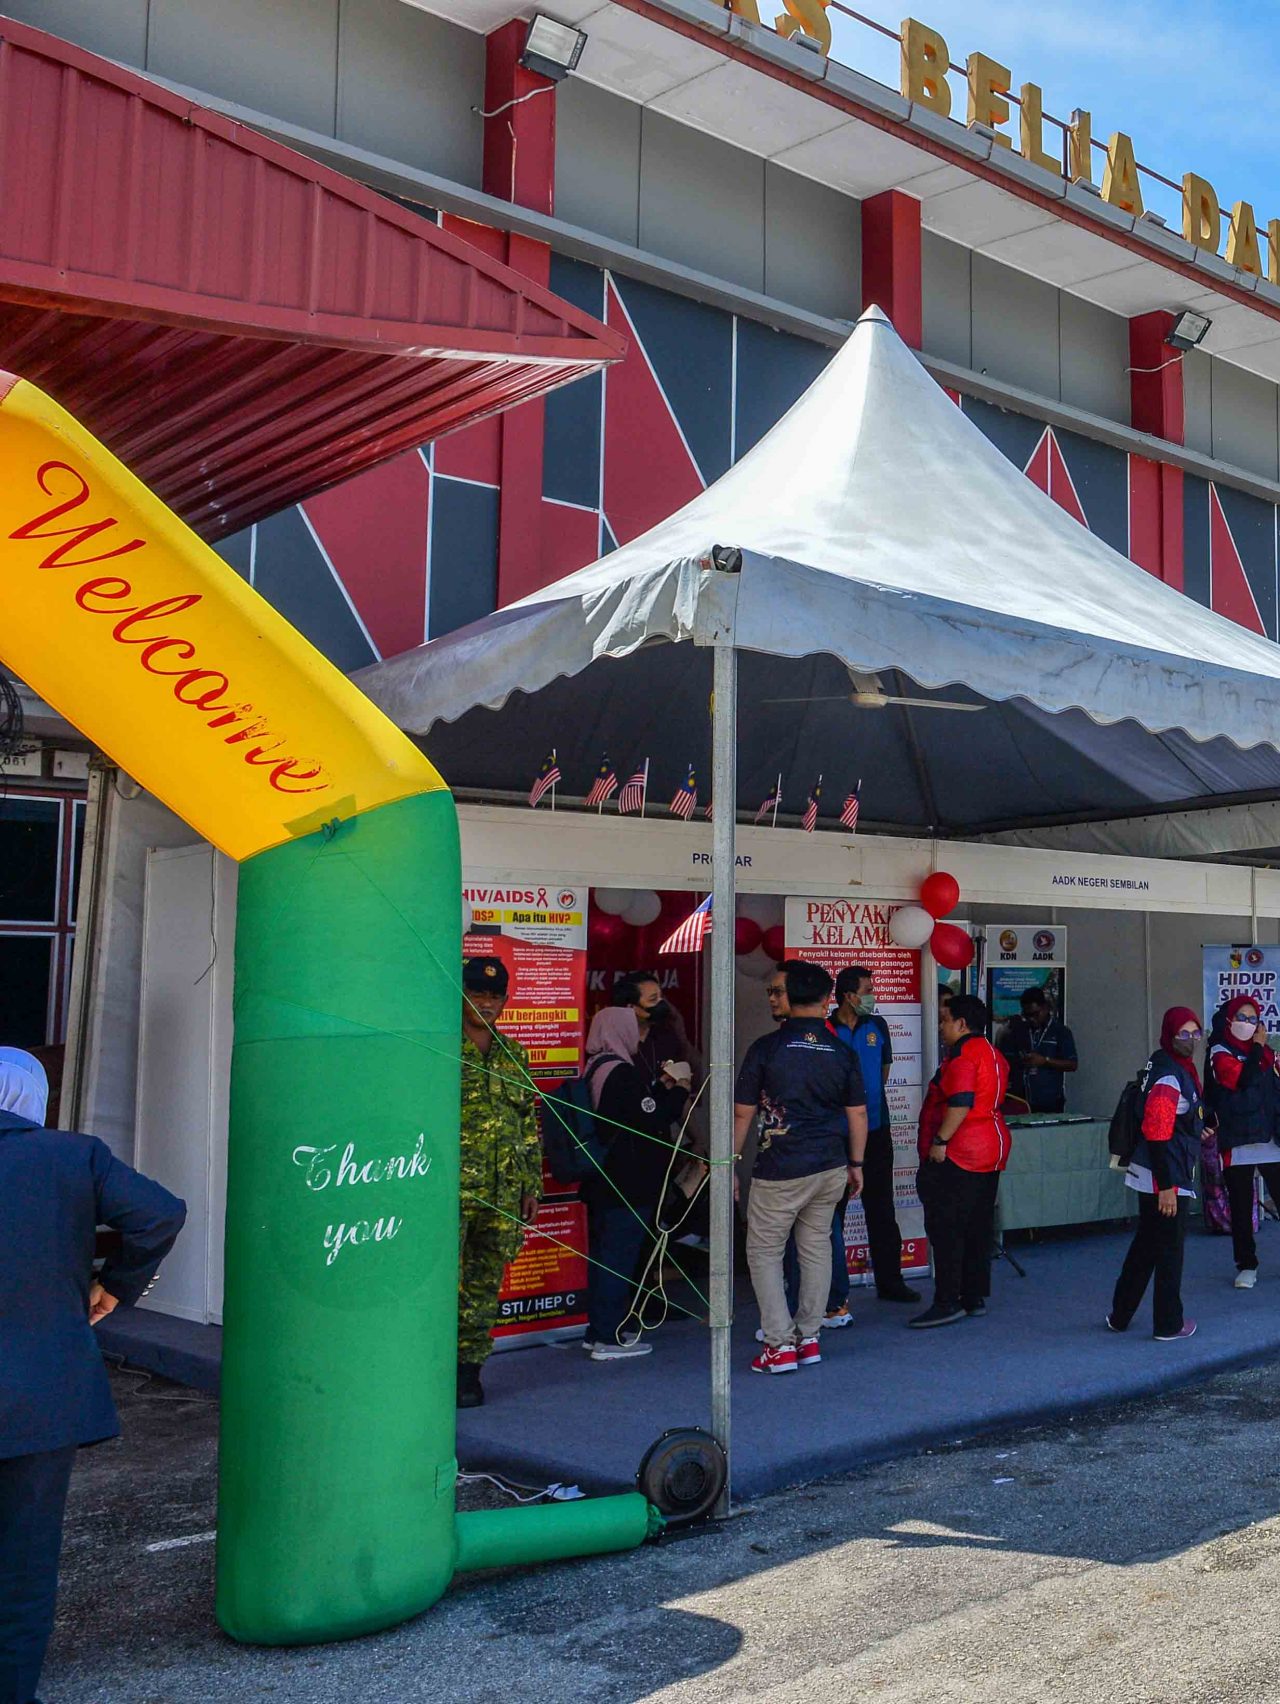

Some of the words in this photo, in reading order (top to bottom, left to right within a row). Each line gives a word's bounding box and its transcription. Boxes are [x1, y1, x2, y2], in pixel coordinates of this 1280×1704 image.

[712, 0, 832, 58] S
[900, 16, 1144, 217] BELIA
[8, 460, 335, 794] Welcome
[692, 852, 753, 867] PRAR
[1052, 875, 1076, 886] AADK
[1078, 876, 1108, 888] NEGERI
[1110, 879, 1149, 890] SEMBILAN
[513, 911, 531, 924] Apa
[533, 912, 546, 923] itu
[549, 912, 571, 924] HIV?
[806, 900, 905, 925] PENYAKI
[798, 950, 829, 959] Penyakit
[859, 951, 897, 959] disebarkan
[1001, 952, 1017, 960] KDN
[1033, 952, 1054, 960] AADK
[1219, 972, 1276, 986] HIDUP
[1220, 988, 1275, 1001] SIHAT
[516, 1009, 567, 1021] berjangkit
[531, 1050, 547, 1061] HIV
[292, 1132, 432, 1191] Thank
[323, 1216, 403, 1266] you
[502, 1300, 523, 1315] STI
[535, 1295, 562, 1311] HEP
[566, 1294, 576, 1306] C
